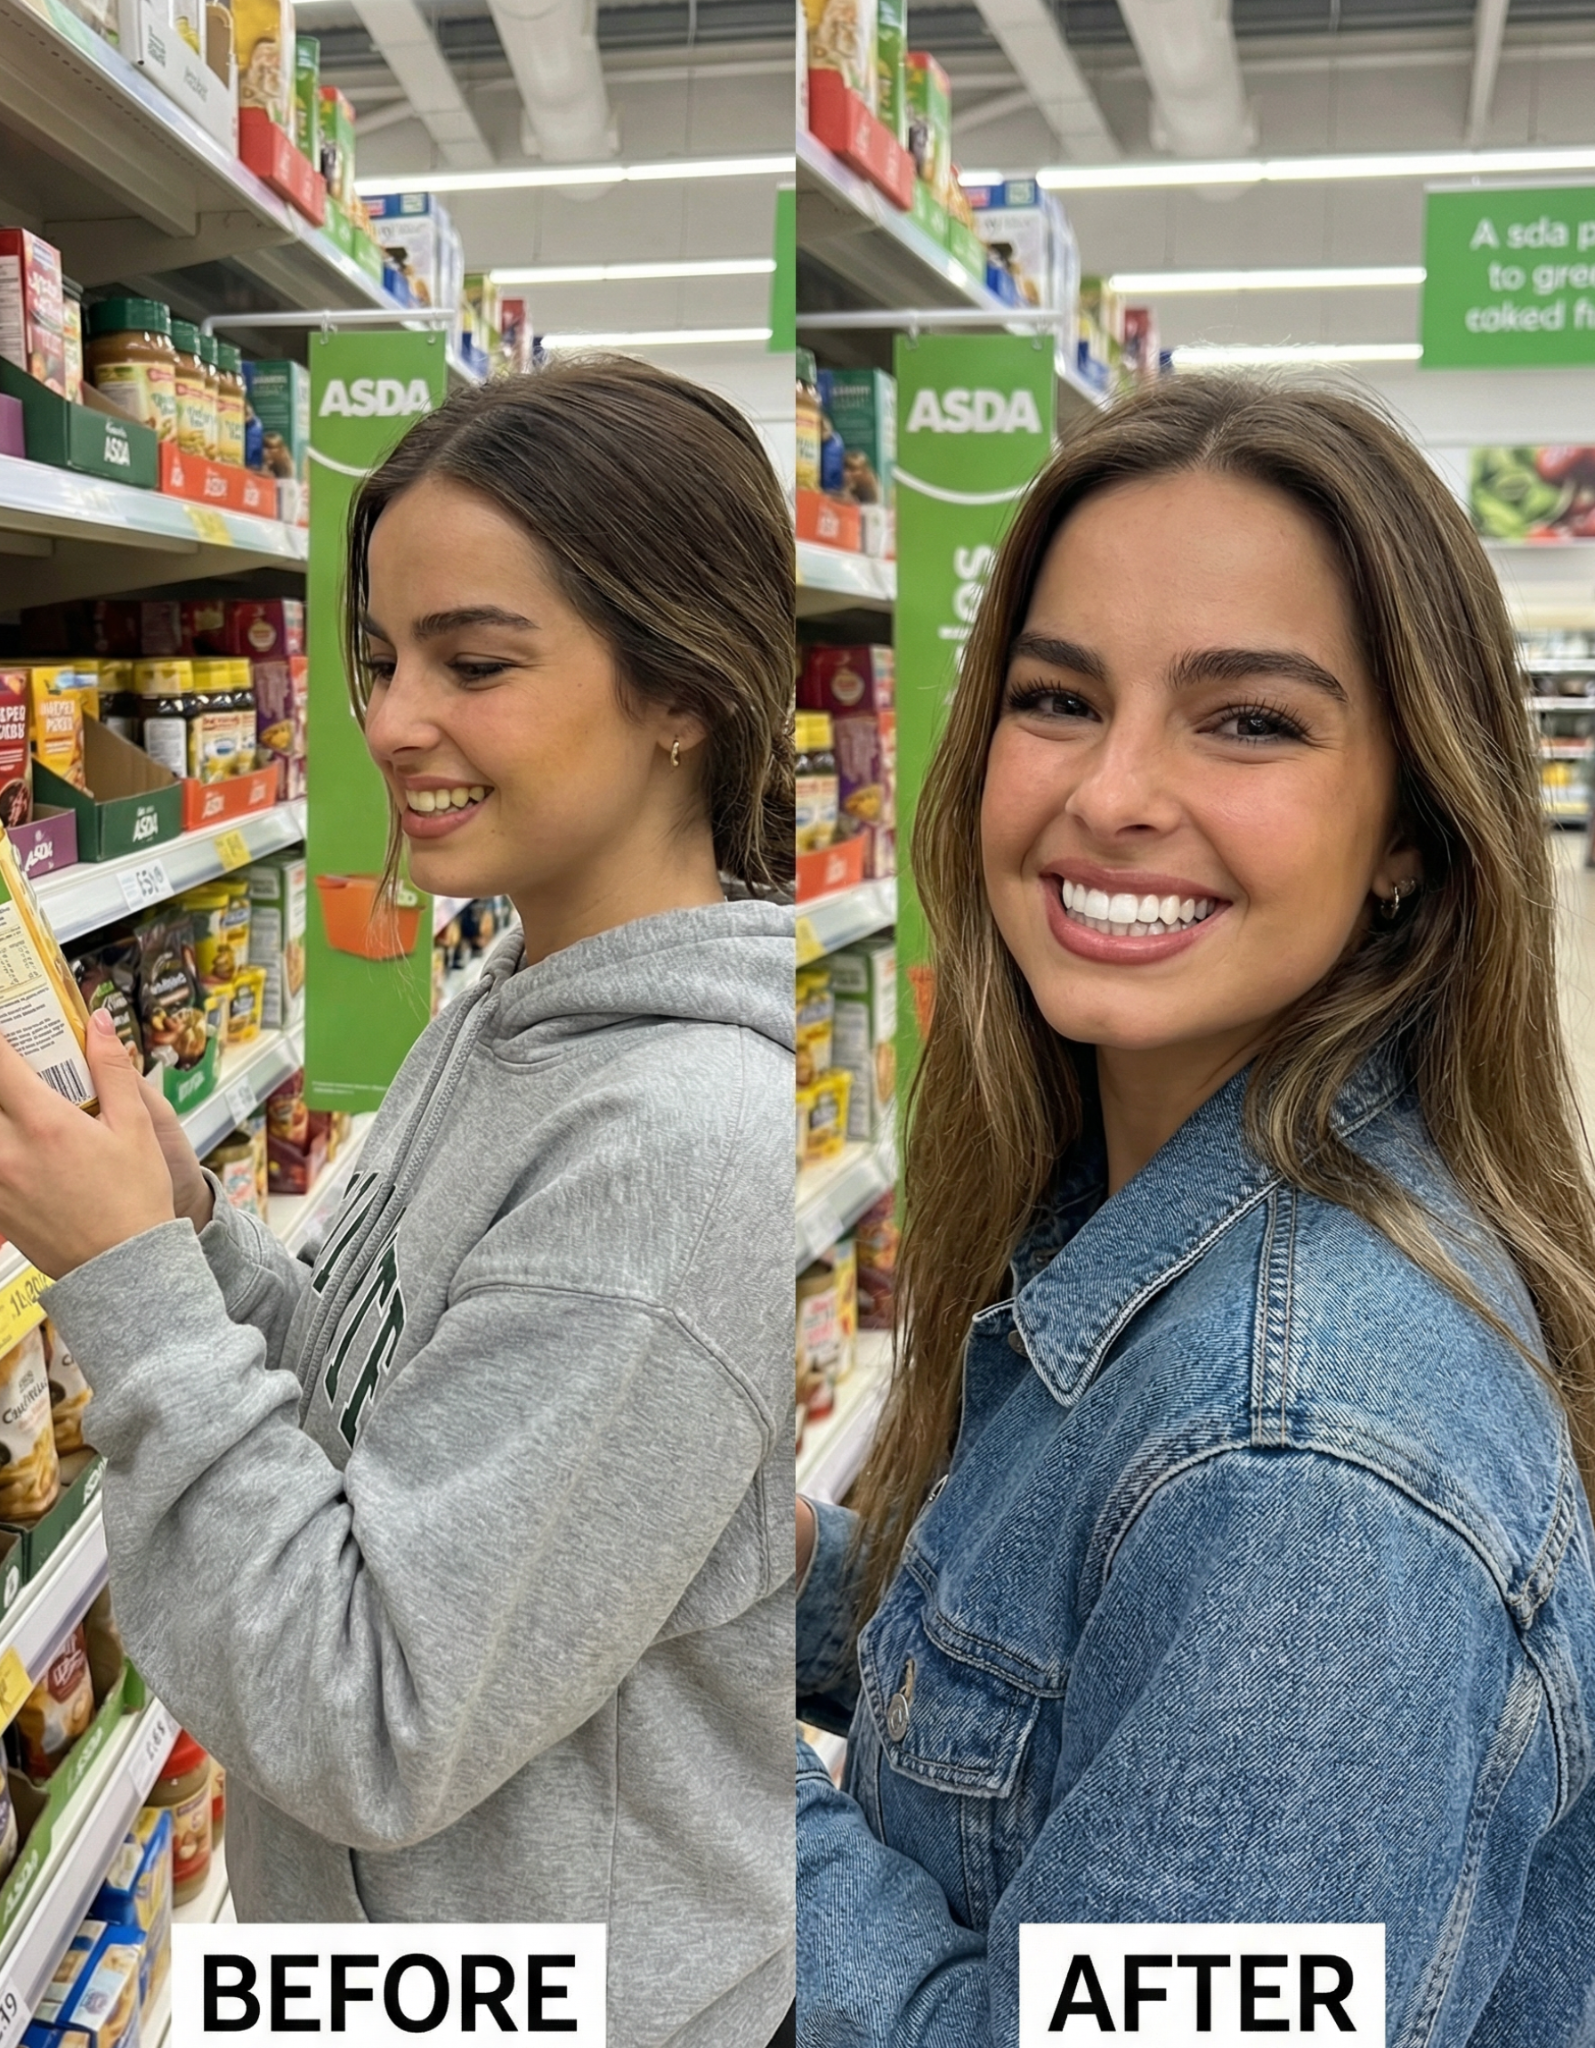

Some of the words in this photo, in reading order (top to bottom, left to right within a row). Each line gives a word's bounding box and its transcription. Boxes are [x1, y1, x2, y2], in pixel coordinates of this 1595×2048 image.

[1469, 217, 1501, 251] A
[1488, 261, 1526, 292] to
[318, 378, 432, 417] ASDA
[906, 387, 1043, 433] ASDA
